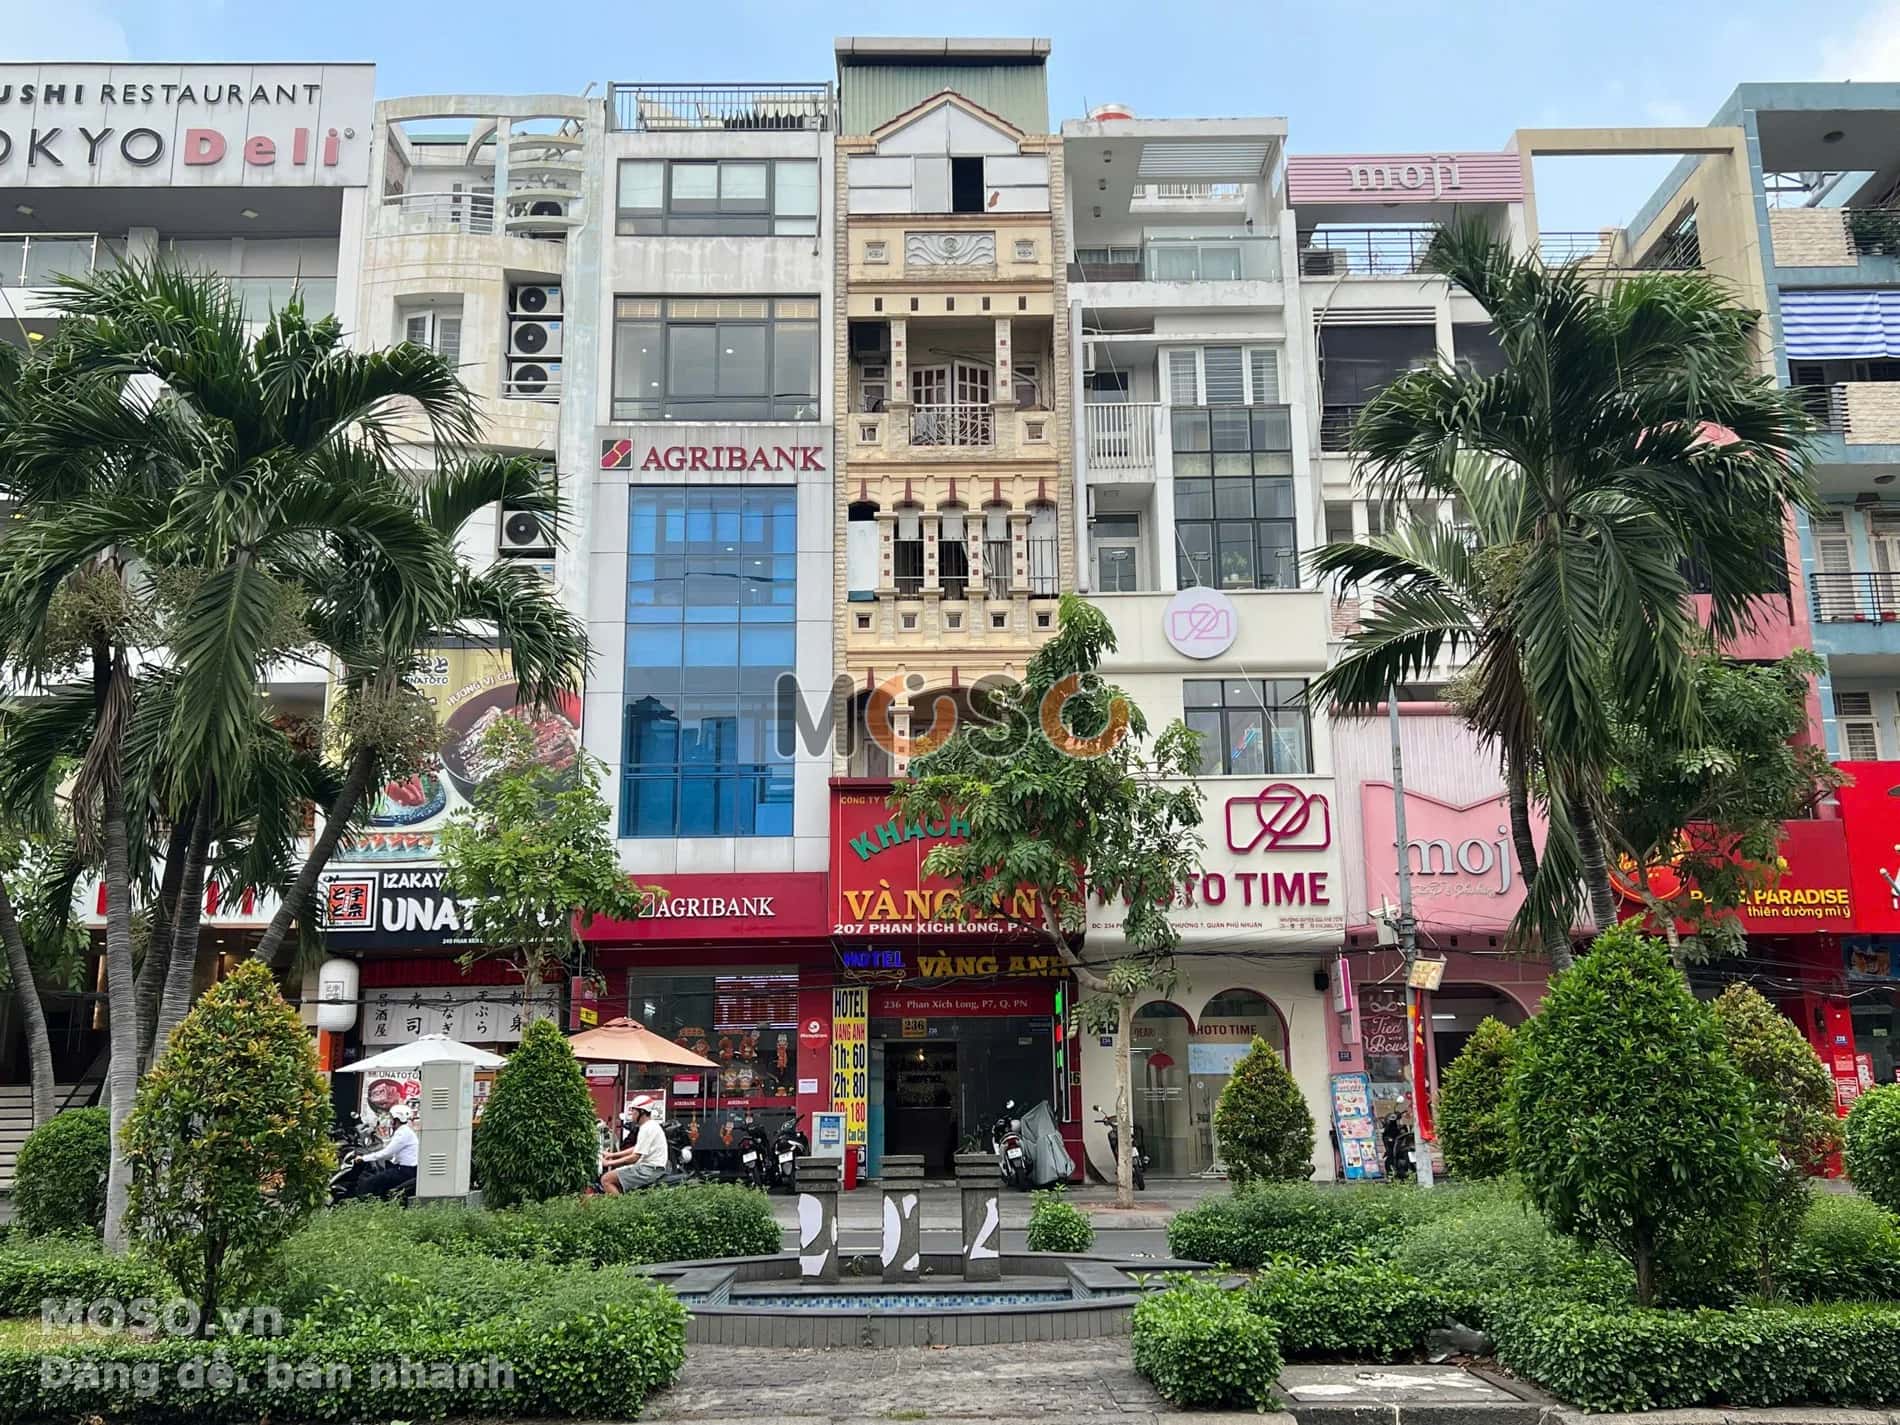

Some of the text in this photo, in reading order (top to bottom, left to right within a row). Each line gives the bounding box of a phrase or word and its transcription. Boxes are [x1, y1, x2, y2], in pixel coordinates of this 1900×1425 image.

[100, 84, 320, 105] RESTAURANT
[0, 127, 165, 167] KYO
[1347, 154, 1462, 200] moji
[641, 446, 826, 472] AGRIBANK
[1393, 825, 1525, 895] moj
[843, 879, 965, 921] VÀNG
[1234, 872, 1330, 906] TIME
[1754, 888, 1850, 905] PARADISE
[656, 896, 776, 918] AGRIBANK
[1748, 906, 1779, 917] thiên
[1782, 906, 1822, 919] đường
[1825, 906, 1841, 917] mì
[833, 923, 864, 935] 207
[869, 923, 913, 934] PHAN
[917, 949, 999, 976] VÀNG
[834, 990, 865, 1018] HOTEL
[907, 1000, 929, 1009] Phan
[955, 1000, 979, 1011] Long,
[852, 1023, 865, 1041] ANH
[904, 1020, 925, 1031] 236
[1228, 1024, 1257, 1035] TIME
[834, 1043, 850, 1070] 1h:
[852, 1043, 865, 1070] 60
[834, 1072, 850, 1098] 2h:
[852, 1072, 865, 1098] 80
[850, 1102, 865, 1122] 180
